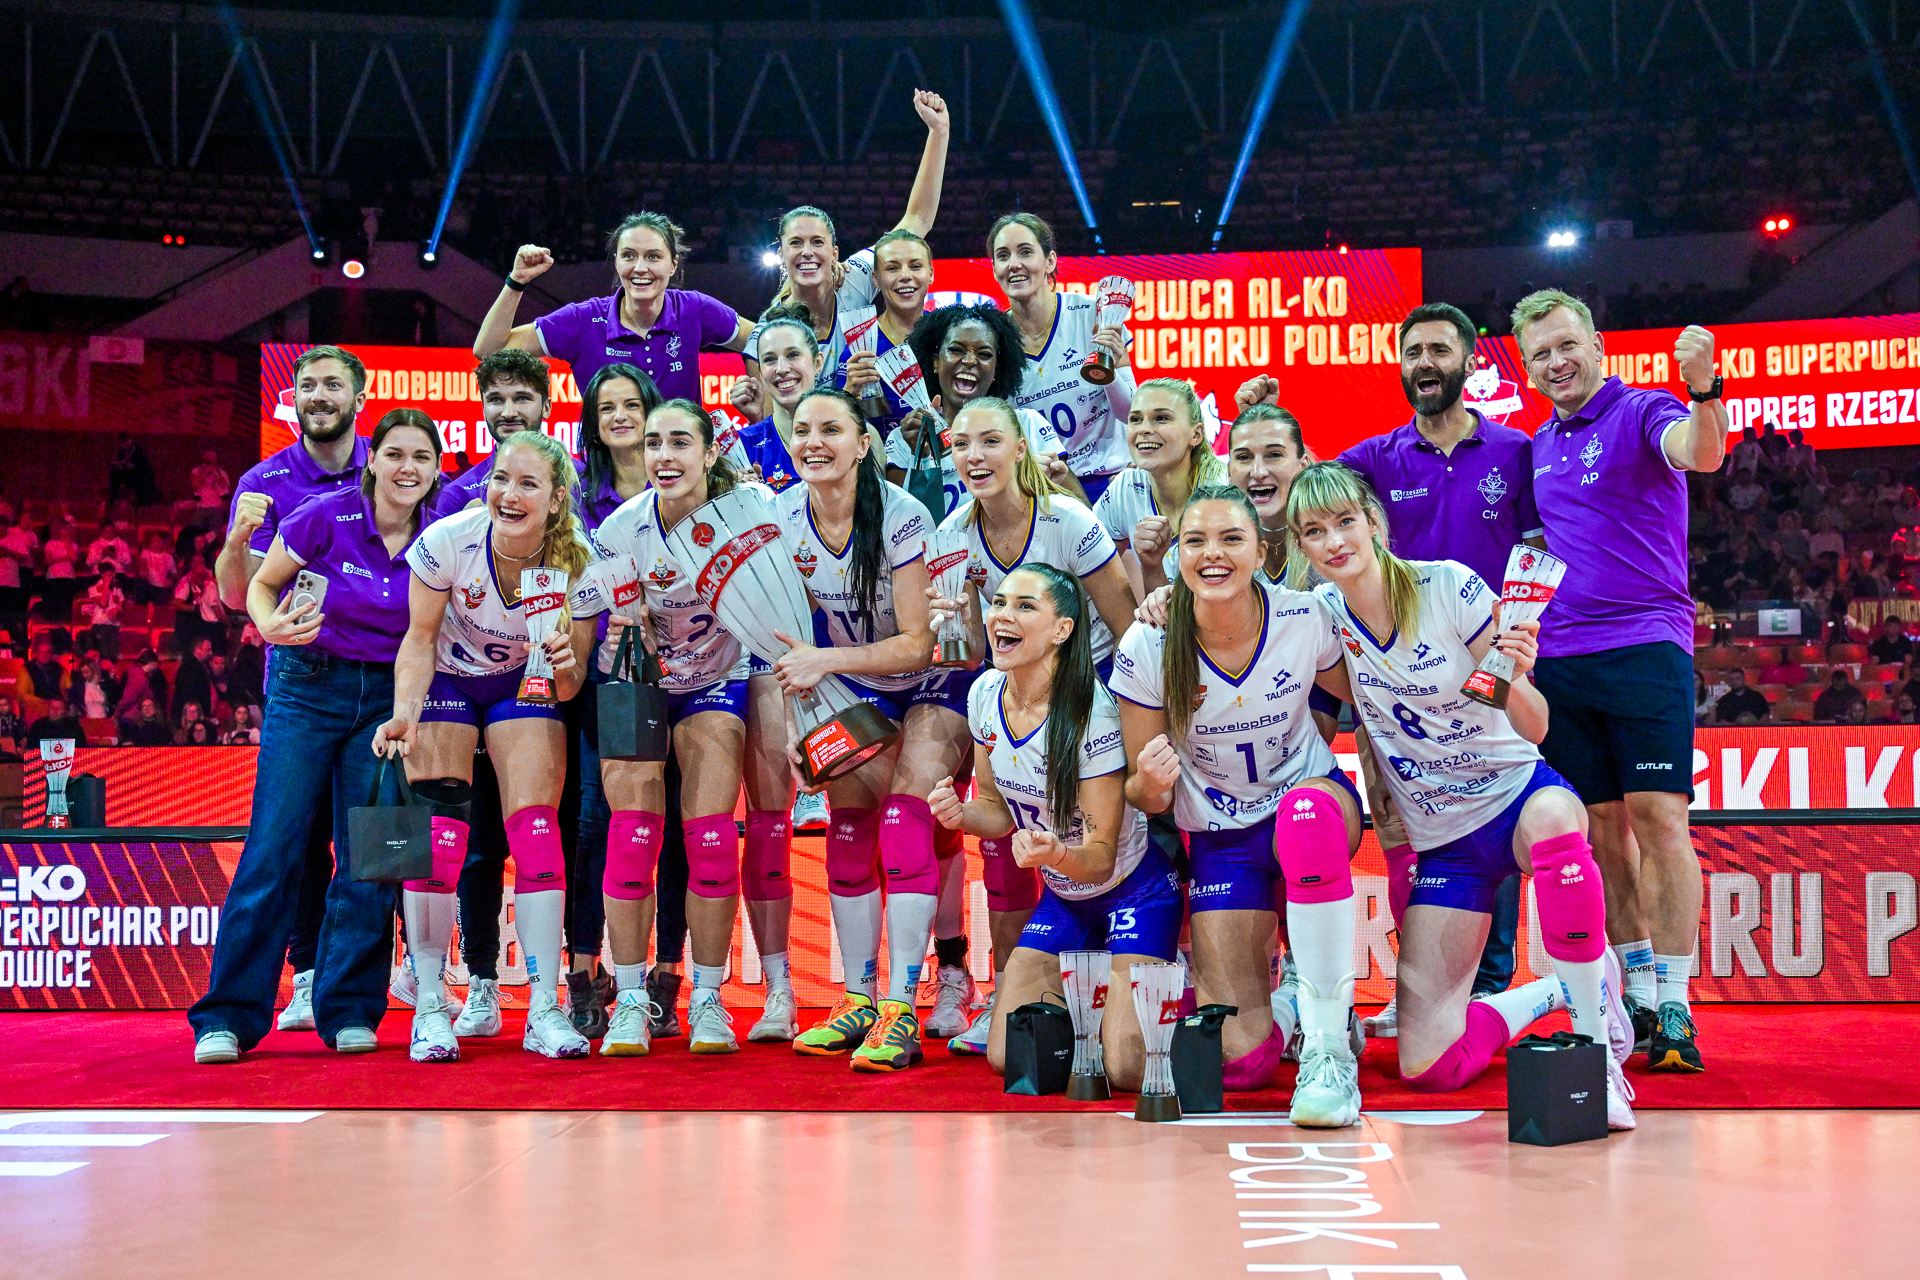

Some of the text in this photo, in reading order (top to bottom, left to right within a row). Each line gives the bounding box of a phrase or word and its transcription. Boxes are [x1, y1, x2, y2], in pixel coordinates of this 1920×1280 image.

[1248, 275, 1348, 319] AL-KO
[669, 361, 683, 373] JB
[1015, 379, 1080, 407] DevelopRes
[1826, 388, 1920, 428] RZESZ
[262, 468, 291, 479] CUTLINE
[1580, 471, 1600, 487] AP
[1482, 509, 1499, 521] CH
[897, 514, 922, 540] PGOP
[1276, 607, 1310, 618] CUTLINE
[1771, 612, 1789, 632] E
[687, 614, 714, 643] 2
[483, 643, 512, 663] 6
[1407, 654, 1447, 674] TAURON
[706, 680, 729, 698] 2
[912, 692, 950, 701] CUTLINE
[1264, 682, 1301, 702] TAURON
[694, 697, 735, 707] CUTLINE
[1441, 699, 1459, 710] BMW
[1195, 711, 1289, 735] DevelopRes
[1392, 703, 1429, 740] 8
[1093, 730, 1121, 749] PGOP
[1436, 724, 1484, 744] SPECJAŁ
[1235, 742, 1259, 783] 1
[1636, 762, 1673, 771] CUTLINE
[1844, 745, 1920, 809] K
[1293, 811, 1316, 822] errea
[532, 827, 550, 835] errea
[438, 838, 456, 847] errea
[1561, 874, 1584, 885] errea
[0, 905, 164, 946] ERPUCHAR
[1107, 907, 1137, 933] 13
[1625, 963, 1656, 975] SKYRES
[1570, 1091, 1589, 1100] INGLOT
